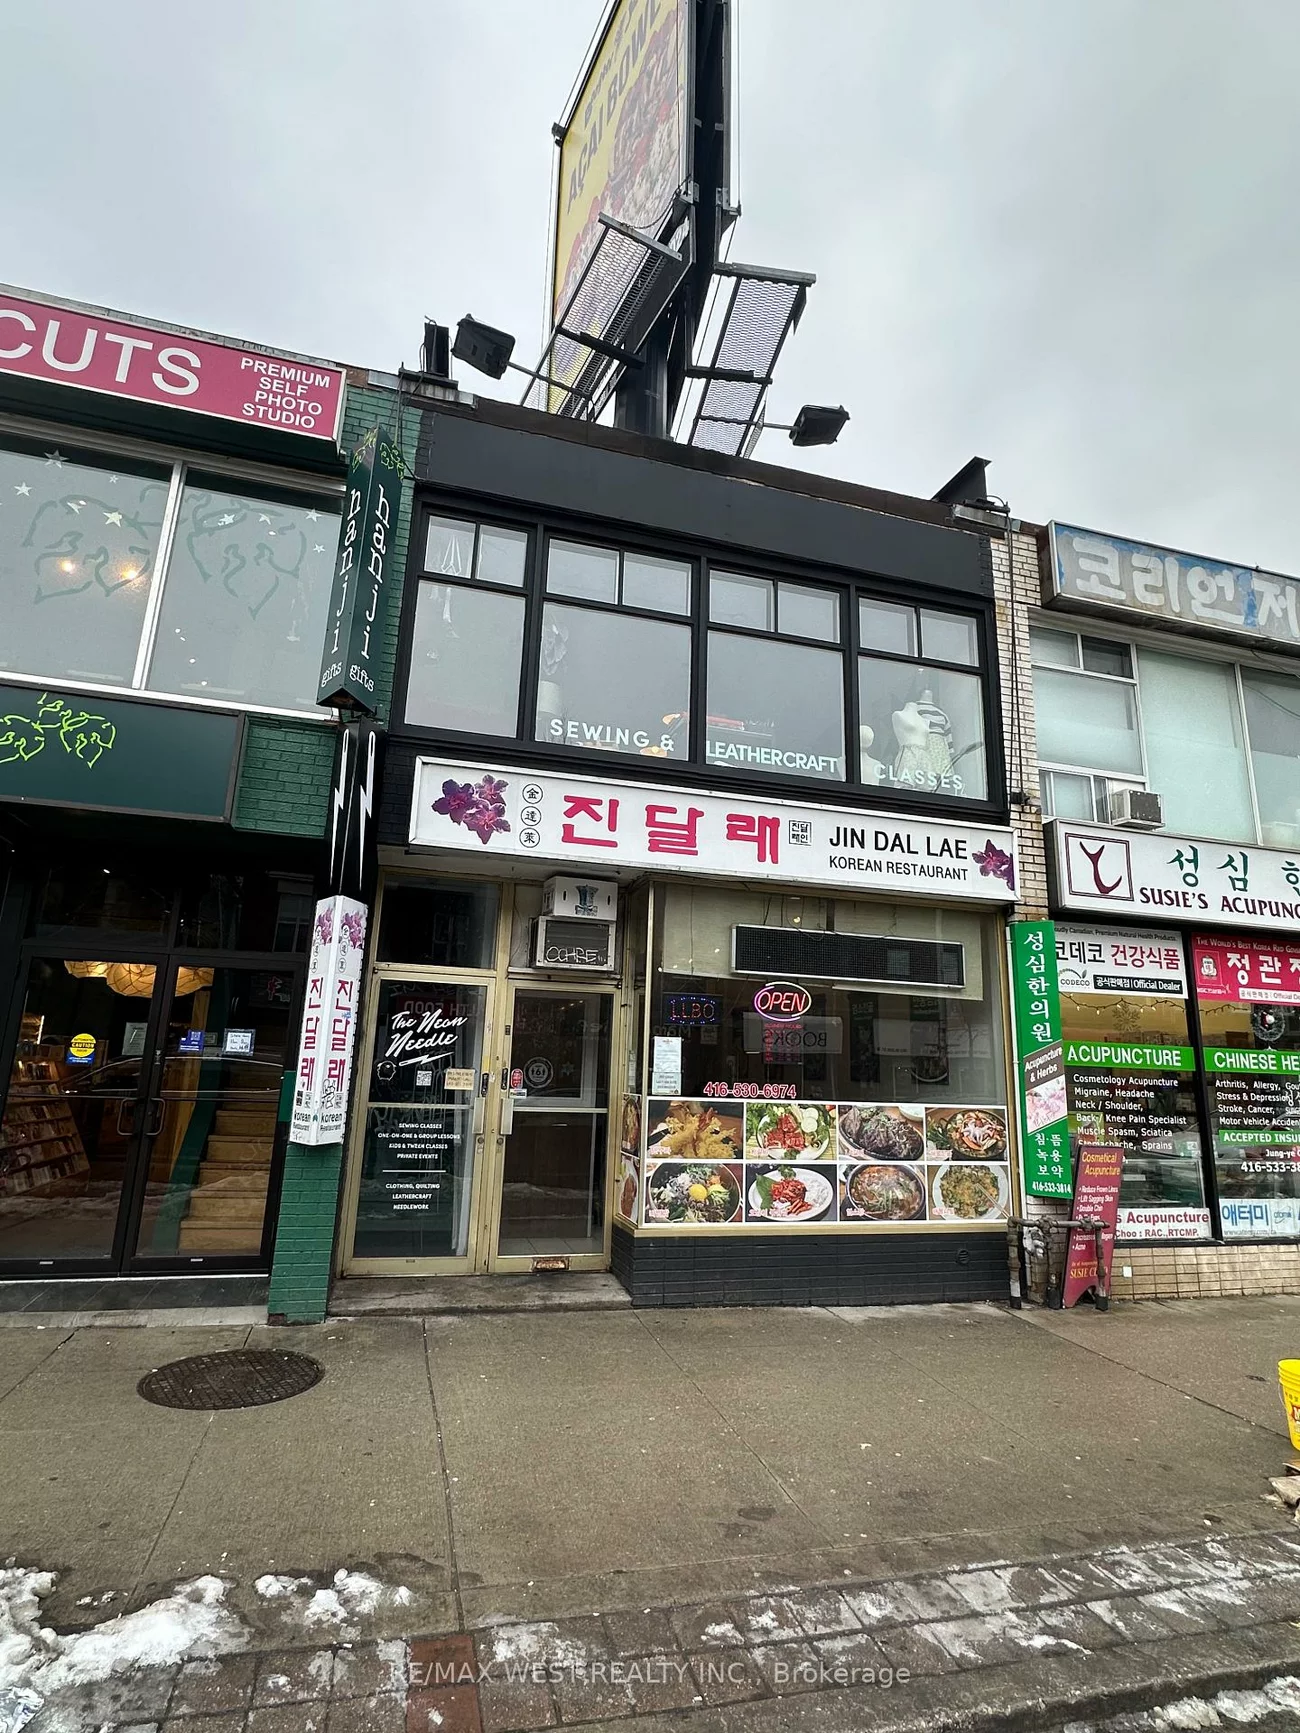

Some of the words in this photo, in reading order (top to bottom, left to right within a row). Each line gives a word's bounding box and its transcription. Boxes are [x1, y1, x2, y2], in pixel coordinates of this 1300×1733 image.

[0, 309, 202, 396] CUTS
[241, 356, 331, 388] PREMIUM
[259, 376, 308, 396] SELF
[255, 390, 323, 416] PHOTO
[242, 402, 316, 429] STUDIO
[1073, 537, 1246, 626] 코리언
[321, 661, 342, 688] gifts
[350, 664, 375, 692] gifts
[550, 719, 650, 747] SEWING
[660, 734, 674, 752] &
[705, 740, 837, 773] LEATHERCRAFT
[873, 764, 963, 790] CLASSES
[561, 795, 780, 865] 진달래
[829, 826, 865, 849] JIN
[873, 830, 919, 854] DAL
[926, 836, 968, 859] LAE
[829, 856, 883, 873] KOREAN
[886, 861, 969, 881] RESTAURANT
[1139, 886, 1209, 909] SUSIE'S
[1110, 945, 1181, 970] 건강식품
[1024, 931, 1054, 1044] 성심한의원
[1060, 978, 1090, 987] CODECO
[1133, 980, 1158, 990] Official
[1158, 981, 1181, 991] Dealer
[757, 991, 807, 1012] OPEN
[391, 1010, 417, 1030] The
[299, 976, 324, 1092] 진달래
[327, 978, 354, 1092] 진달래
[1025, 1046, 1063, 1072] Acupuncture
[1067, 1045, 1182, 1067] ACUPUNCTURE
[1213, 1051, 1278, 1070] CHINESE
[1036, 1064, 1058, 1080] Herbs
[1073, 1074, 1127, 1086] Cosmetology
[1128, 1076, 1179, 1088] Acupuncture
[703, 1082, 797, 1099] 416-530-6974
[1074, 1087, 1113, 1098] Migraine,
[1115, 1089, 1155, 1098] Headache
[1215, 1079, 1249, 1089] Arthritis,
[1253, 1081, 1281, 1091] Allergy,
[1075, 1101, 1096, 1109] Neck
[1105, 1101, 1143, 1112] Shoulder,
[1216, 1092, 1240, 1100] Stress
[1242, 1092, 1248, 1100] &
[1250, 1092, 1290, 1102] Depression
[1076, 1113, 1095, 1122] Back
[1105, 1114, 1127, 1123] Knee
[1128, 1115, 1147, 1123] Pain
[1148, 1116, 1187, 1125] Specialist
[1218, 1104, 1246, 1114] Stroke,
[1247, 1105, 1275, 1114] Cancer,
[1077, 1126, 1105, 1135] Muscle
[1108, 1127, 1139, 1137] Spasm,
[1141, 1127, 1173, 1137] Sciatica
[1219, 1117, 1241, 1125] Motor
[1243, 1117, 1270, 1126] Vehicle
[1141, 1140, 1172, 1150] Sprains
[1223, 1132, 1272, 1142] ACCEPTED
[1081, 1151, 1117, 1163] Cosmetical
[1265, 1149, 1296, 1158] Jung-ye
[1085, 1164, 1121, 1177] Acupuncture
[1126, 1211, 1209, 1226] Acupuncture
[1221, 1203, 1269, 1227] 애터미
